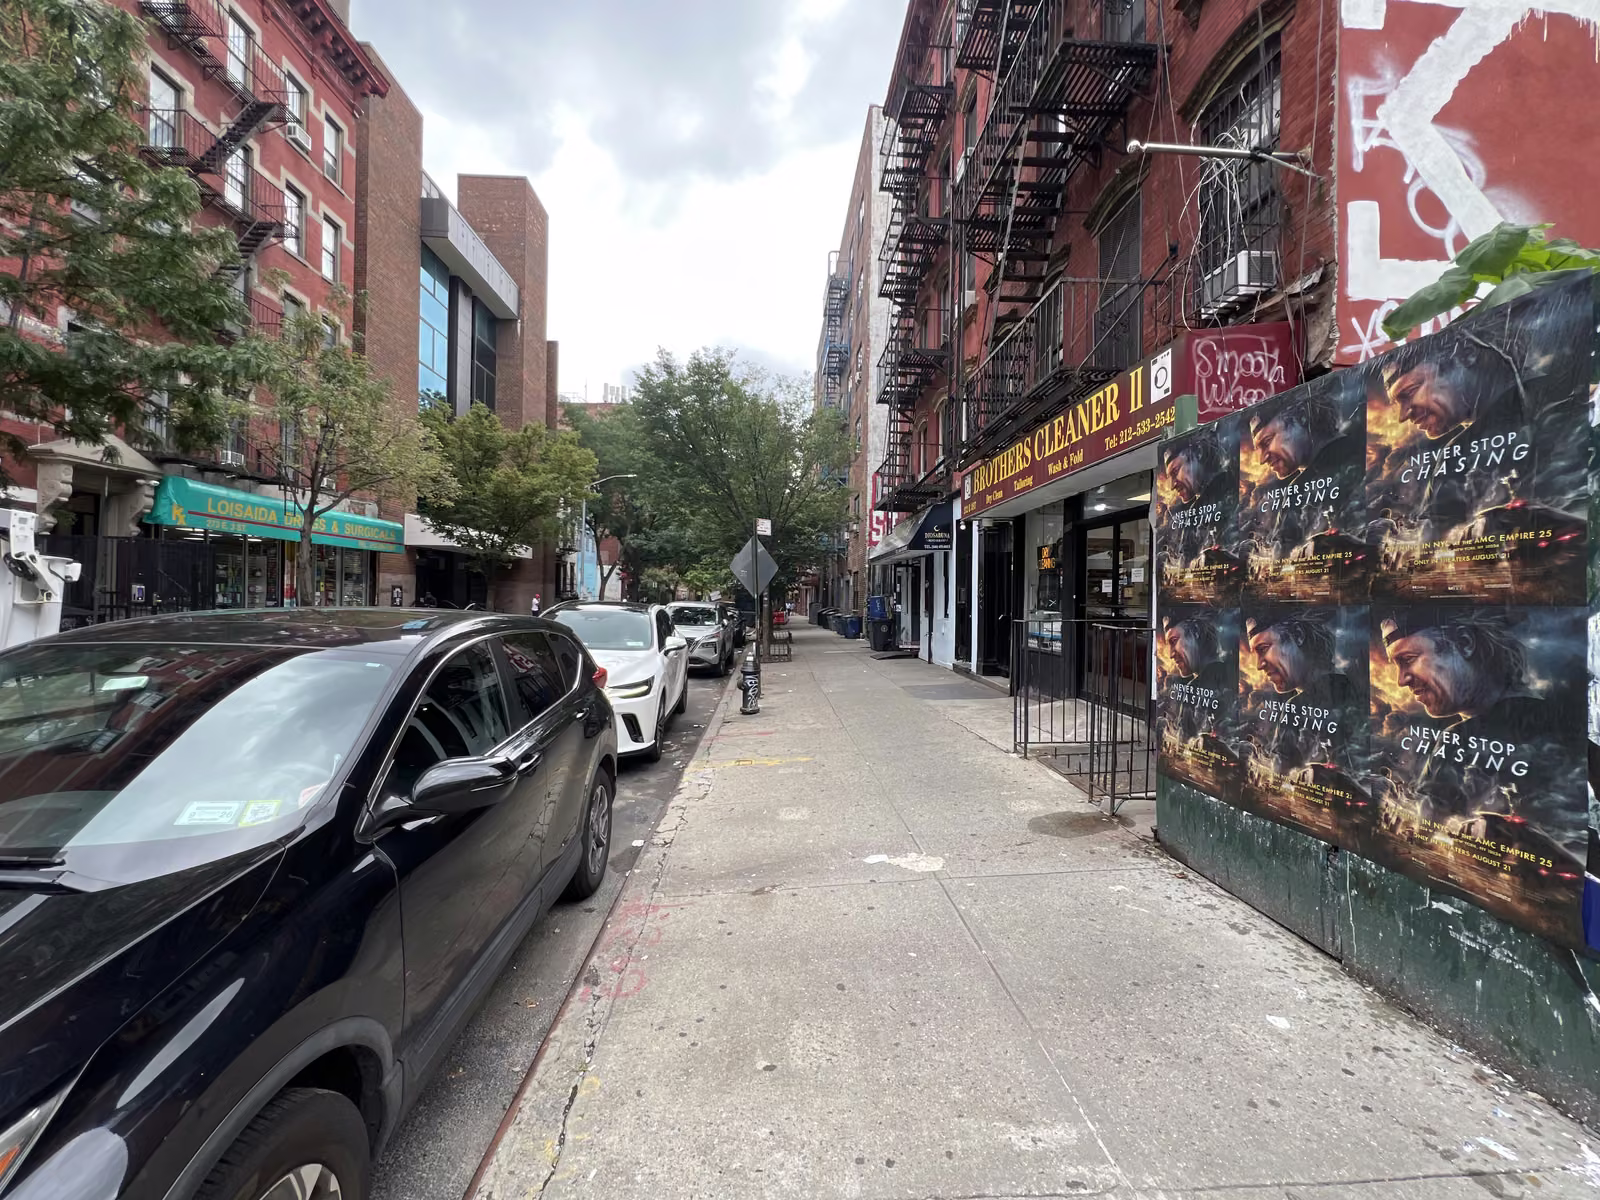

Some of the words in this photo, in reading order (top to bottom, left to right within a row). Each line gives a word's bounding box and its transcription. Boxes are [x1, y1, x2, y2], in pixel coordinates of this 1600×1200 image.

[973, 437, 1031, 495] BROTHERS
[1034, 383, 1120, 461] CLEANER
[1129, 366, 1143, 414] II
[1105, 435, 1118, 451] Tel:
[1119, 406, 1175, 445] 212-533-2542
[1048, 459, 1062, 476] Wash
[1063, 456, 1069, 470] &
[1070, 449, 1084, 467] Fold
[1411, 445, 1461, 467] NEVER
[1470, 432, 1517, 453] STOP
[1401, 444, 1529, 484] CHASING
[1261, 486, 1340, 513] CHASING
[1267, 484, 1299, 500] NEVER
[1304, 477, 1333, 491] STOP
[208, 498, 279, 525] LOISAIDA
[1171, 512, 1222, 530] CHASING
[1175, 508, 1196, 518] NEVER
[1199, 503, 1217, 514] STOP
[1474, 535, 1496, 545] AMC
[1499, 531, 1535, 542] EMPIRE
[1539, 529, 1552, 538] 25
[1322, 552, 1343, 560] EMPIRE
[1472, 553, 1498, 561] AUGUST
[1170, 690, 1219, 709] CHASING
[1173, 683, 1194, 694] NEVER
[1196, 687, 1214, 698] STOP
[1259, 709, 1338, 734] CHASING
[1265, 700, 1297, 714] NEVER
[1301, 705, 1330, 719] STOP
[1410, 725, 1461, 746] NEVER
[1468, 736, 1516, 756] STOP
[1401, 737, 1529, 776] CHASING
[1322, 786, 1344, 799] EMPIRE
[1414, 832, 1429, 843] ONLY
[1472, 853, 1500, 868] AUGUST
[1503, 863, 1512, 873] 21
[1475, 837, 1496, 849] AMC
[1500, 844, 1536, 862] EMPIRE
[1539, 857, 1553, 868] 25
